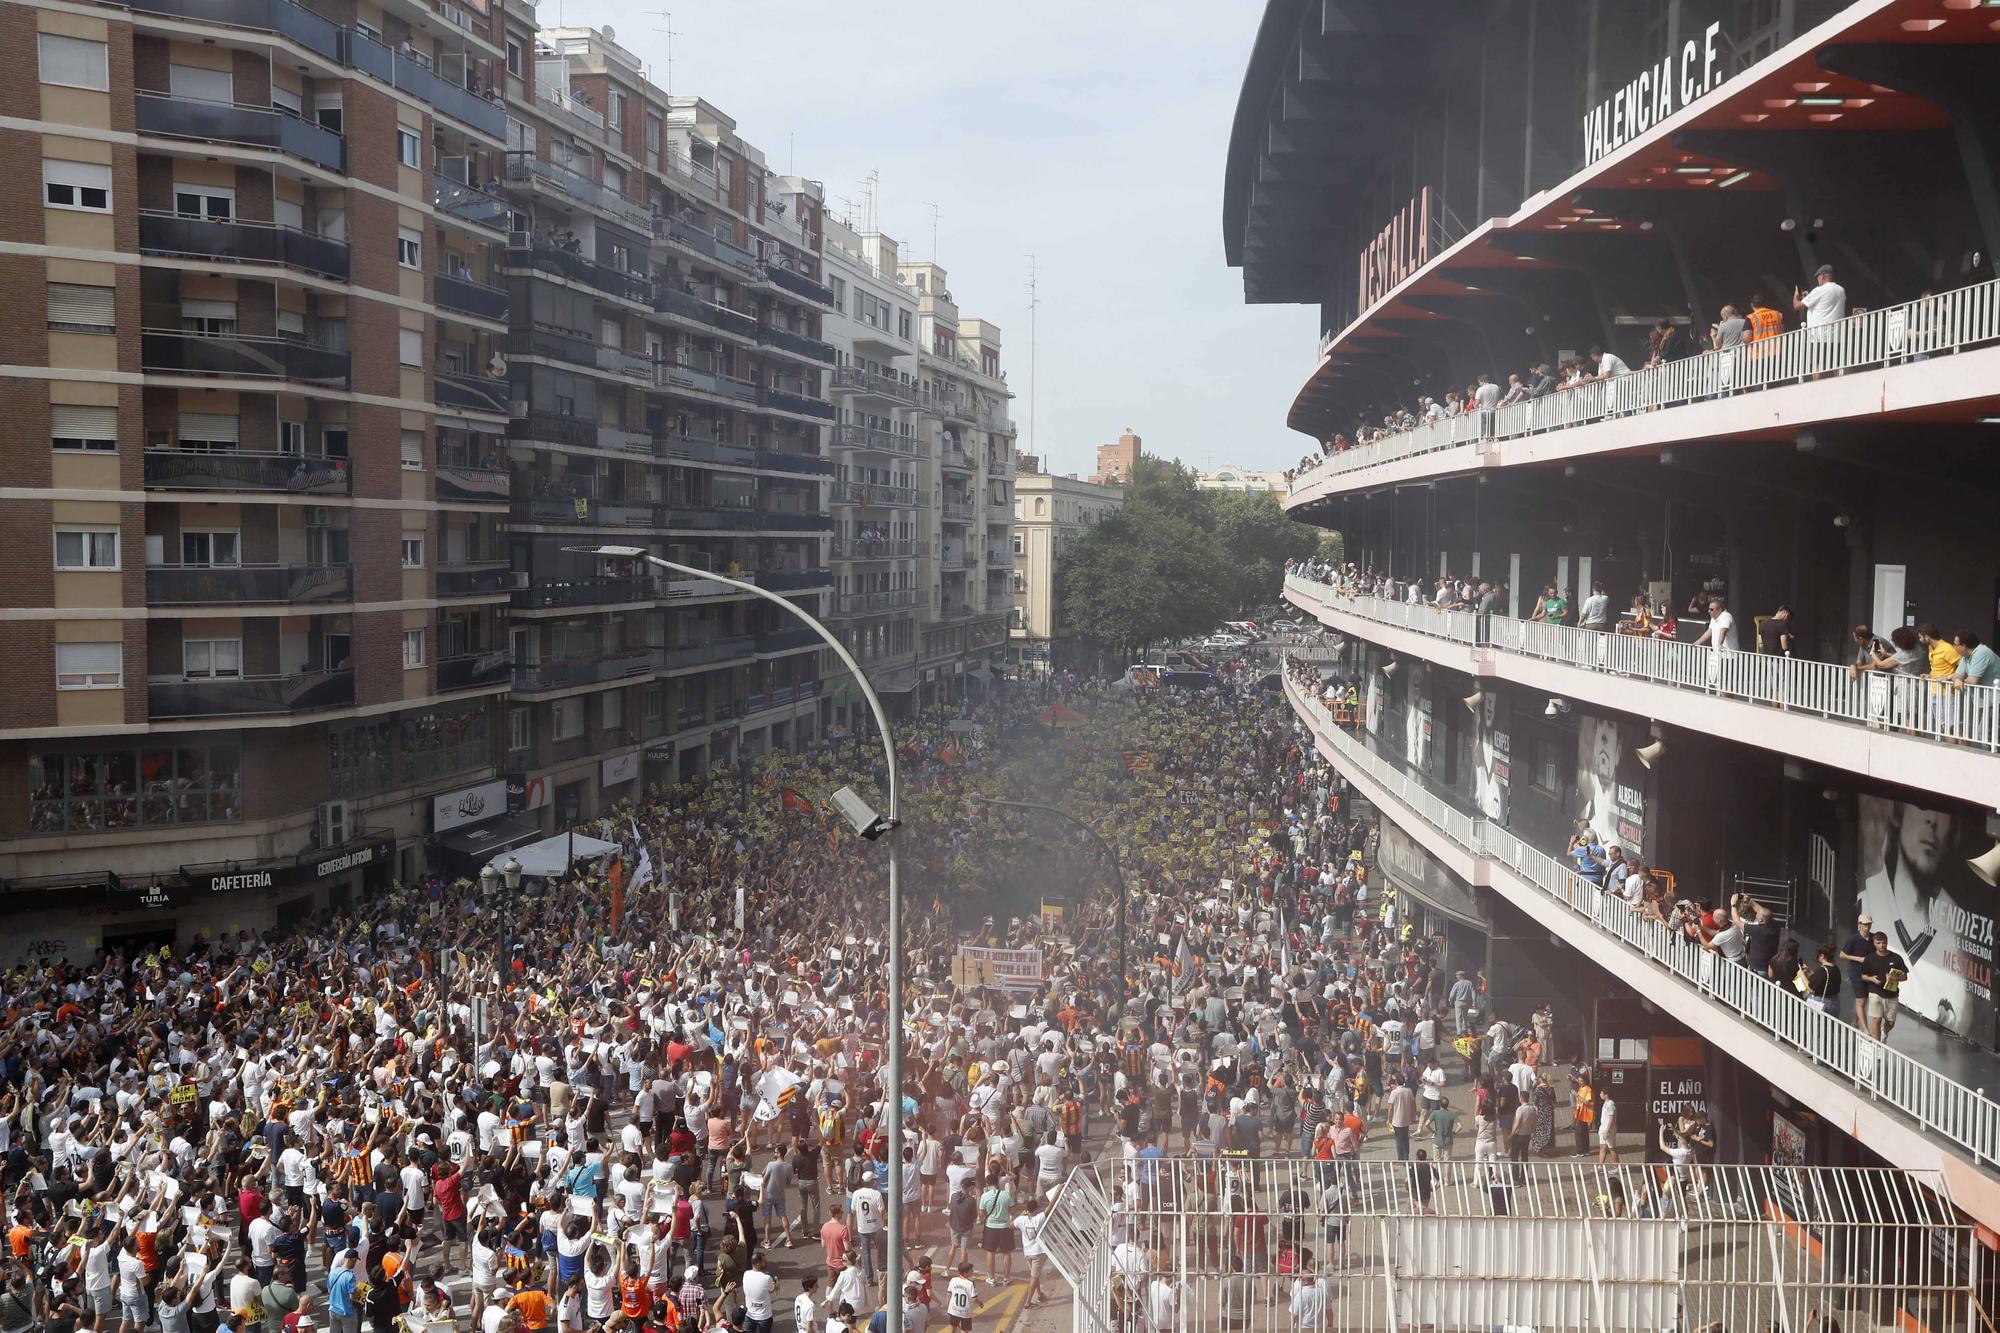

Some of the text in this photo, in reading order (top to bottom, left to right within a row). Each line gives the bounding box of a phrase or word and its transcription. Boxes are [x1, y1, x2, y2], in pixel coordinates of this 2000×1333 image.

[1583, 20, 1722, 168] VALENCIA C.F.
[1359, 185, 1428, 316] MESTALLA
[1617, 784, 1643, 810] ALBELDA
[317, 853, 352, 877] CERVECERÍA
[211, 871, 272, 891] CAFETERÍA
[140, 894, 170, 904] TURIA
[1928, 896, 1994, 947] MENDIETA
[1961, 939, 1992, 962] LEGGENDA
[1942, 949, 1992, 988] MESTALLA
[1389, 1030, 1401, 1042] 18
[175, 1085, 191, 1093] LIM
[1660, 1078, 1702, 1095] EL AÑO
[172, 1095, 196, 1104] HOME
[1652, 1100, 1706, 1114] CENTNA
[451, 1141, 461, 1155] 10
[552, 1158, 559, 1173] 2
[861, 1201, 870, 1216] 9
[954, 1292, 967, 1308] 10
